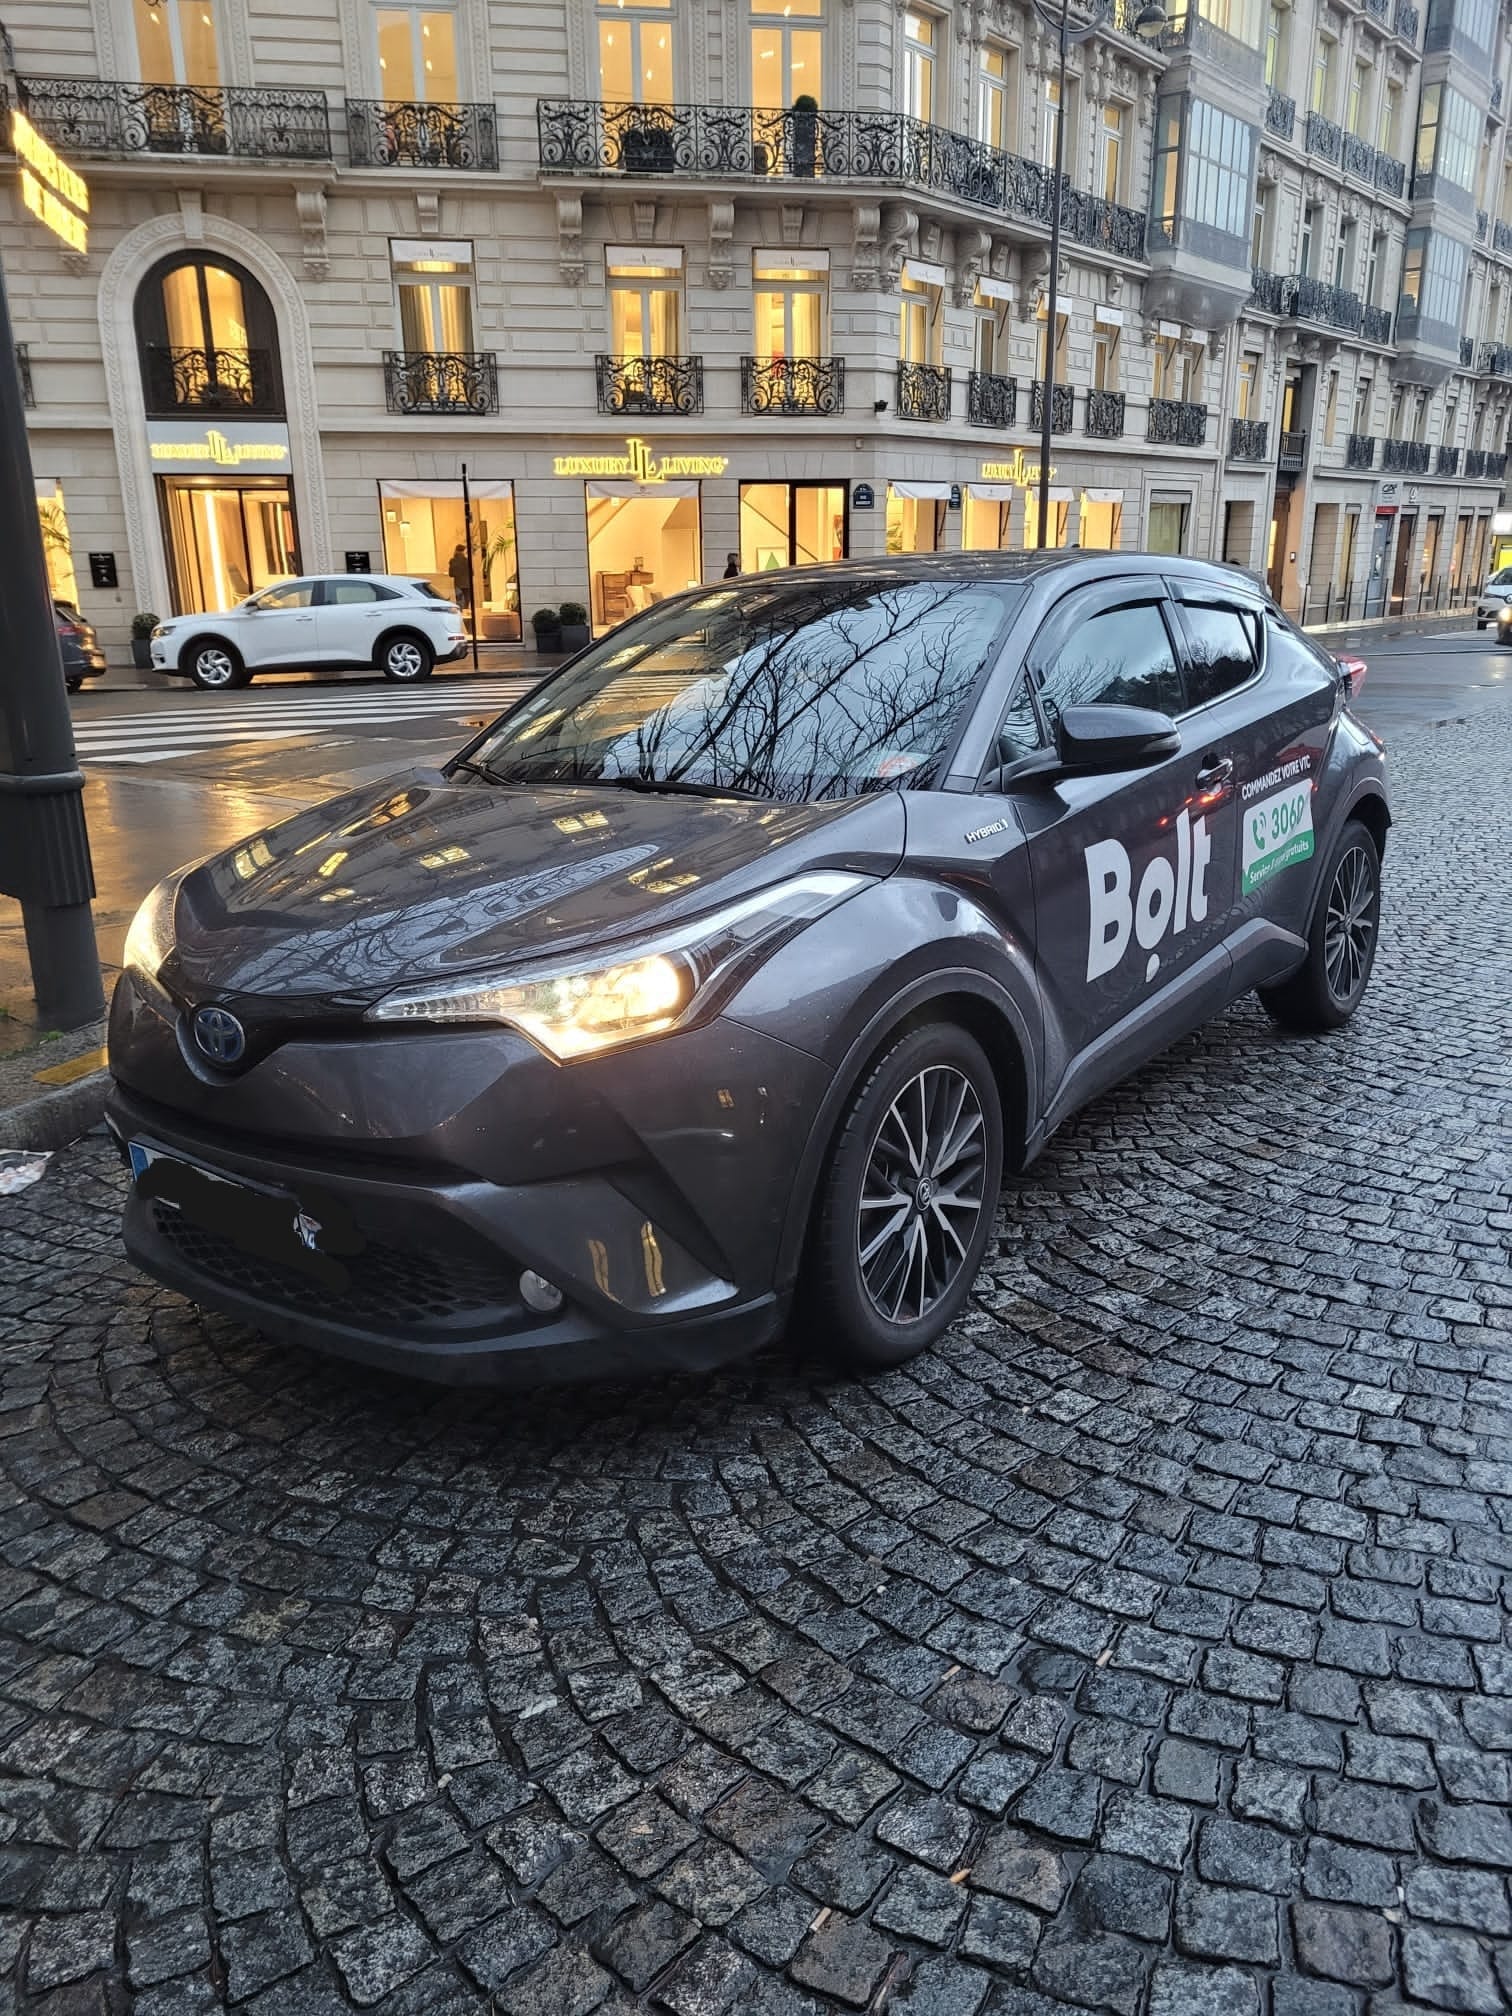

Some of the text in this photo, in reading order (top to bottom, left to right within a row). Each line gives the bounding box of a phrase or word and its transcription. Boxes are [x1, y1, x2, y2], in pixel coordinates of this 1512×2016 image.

[553, 457, 630, 475] LUXURY
[982, 463, 1016, 481] LUXURY
[1241, 754, 1312, 800] COMMANDEZ VOTRE VTC
[964, 818, 1008, 844] HYBRID
[1271, 794, 1305, 839] 3060
[1084, 808, 1212, 983] Bolt
